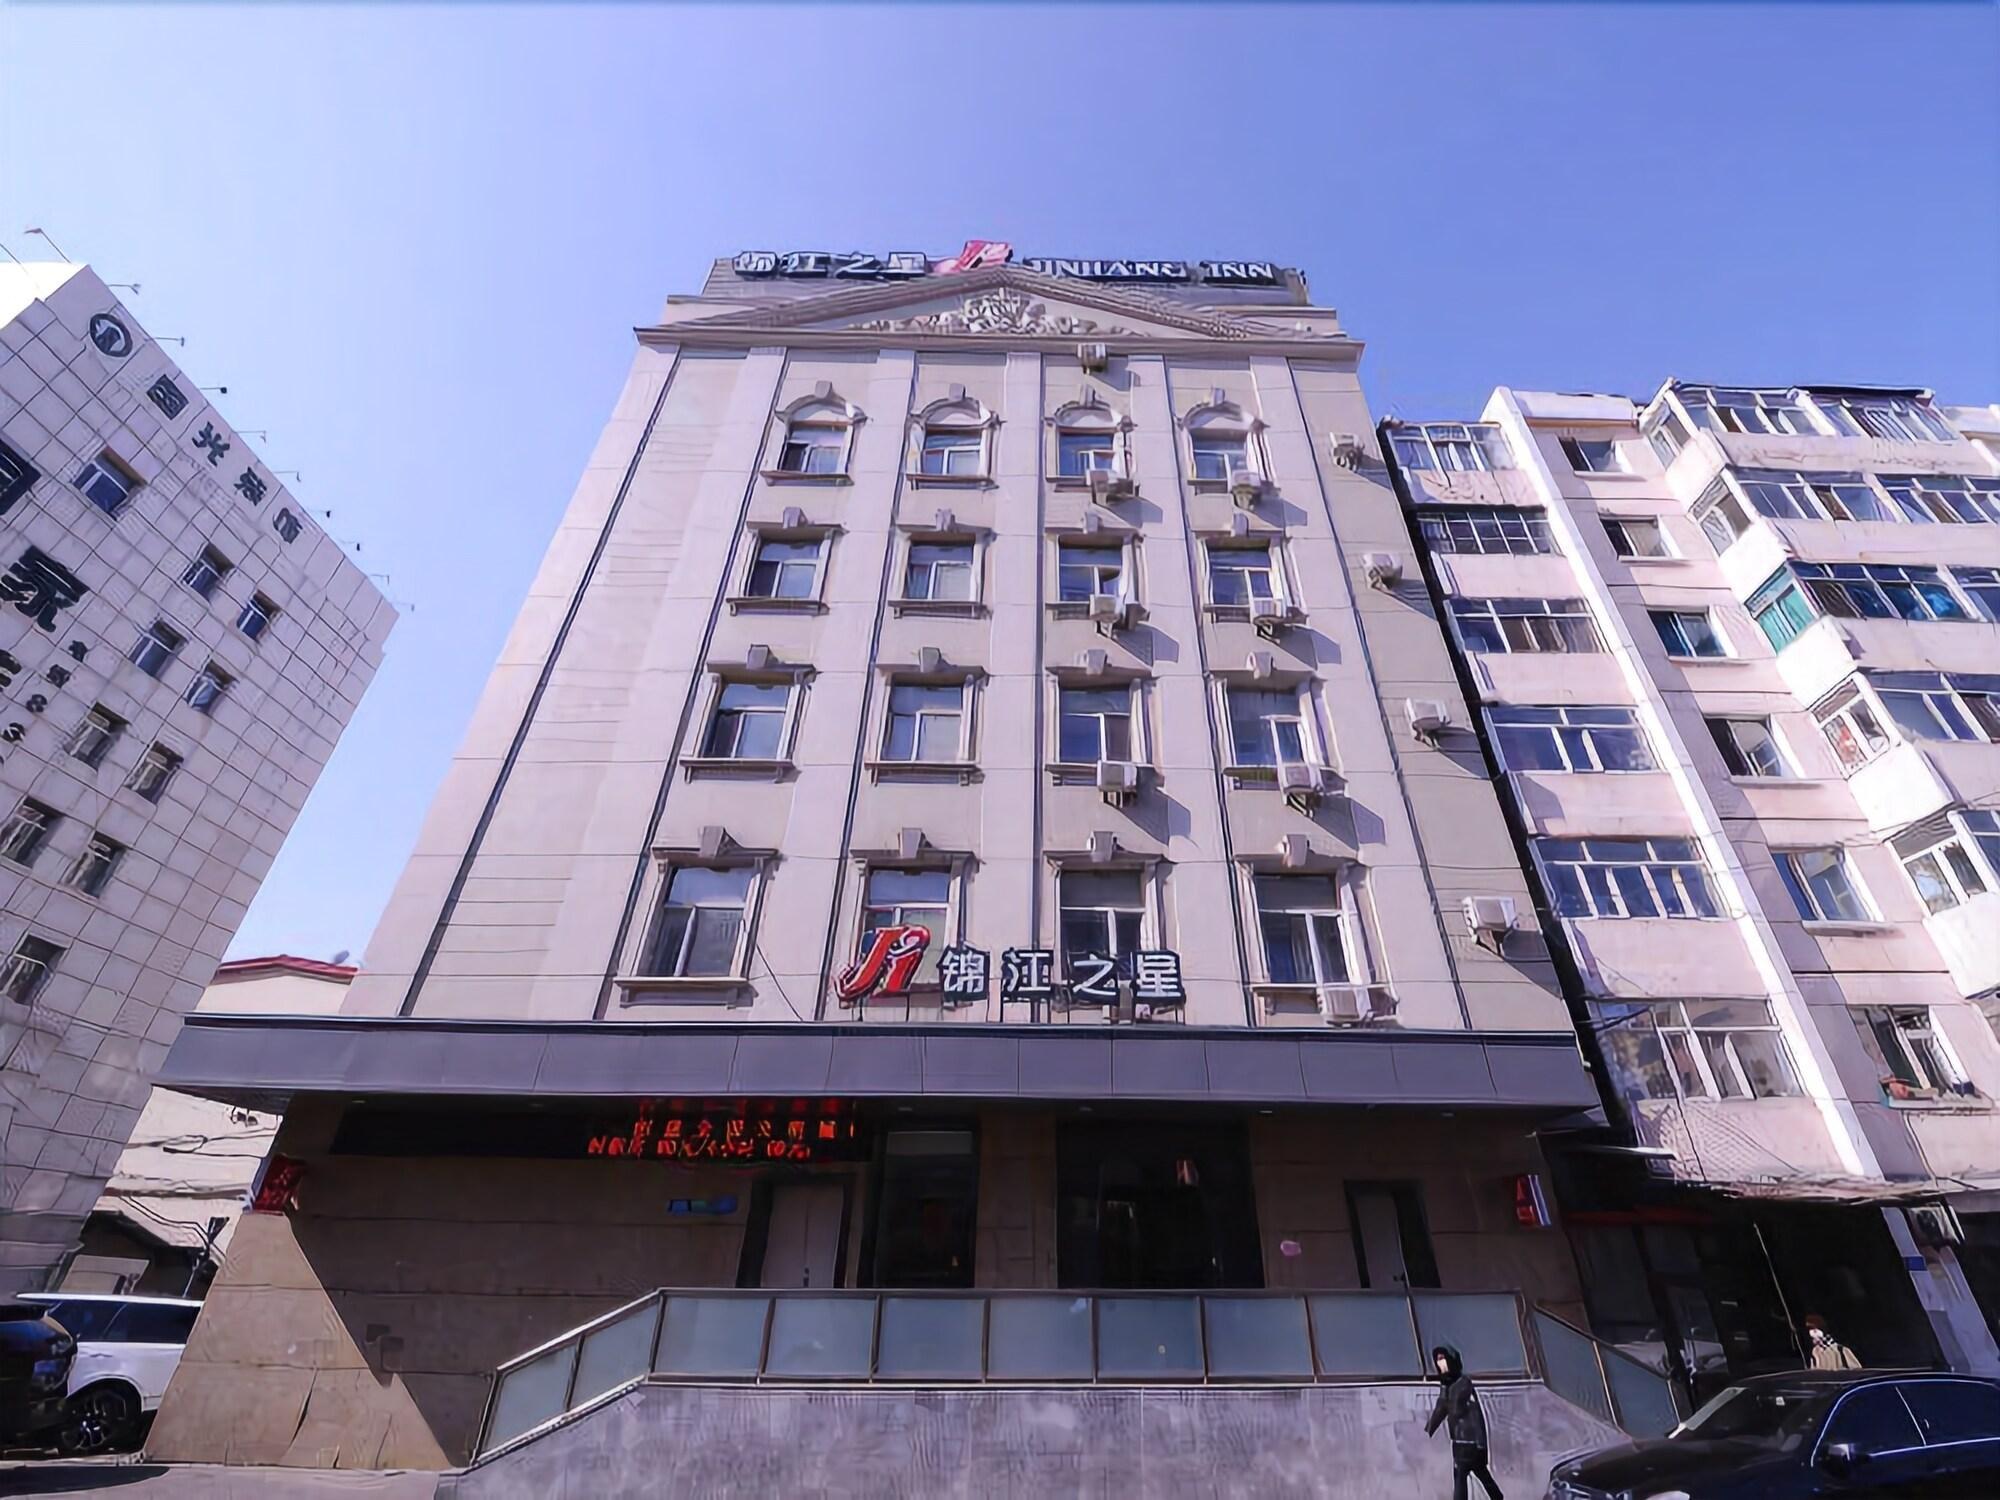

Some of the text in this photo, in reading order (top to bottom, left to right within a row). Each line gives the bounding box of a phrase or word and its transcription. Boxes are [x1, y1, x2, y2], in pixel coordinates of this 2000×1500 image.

[1206, 262, 1274, 279] INN
[941, 949, 1182, 999] 锦江之星
